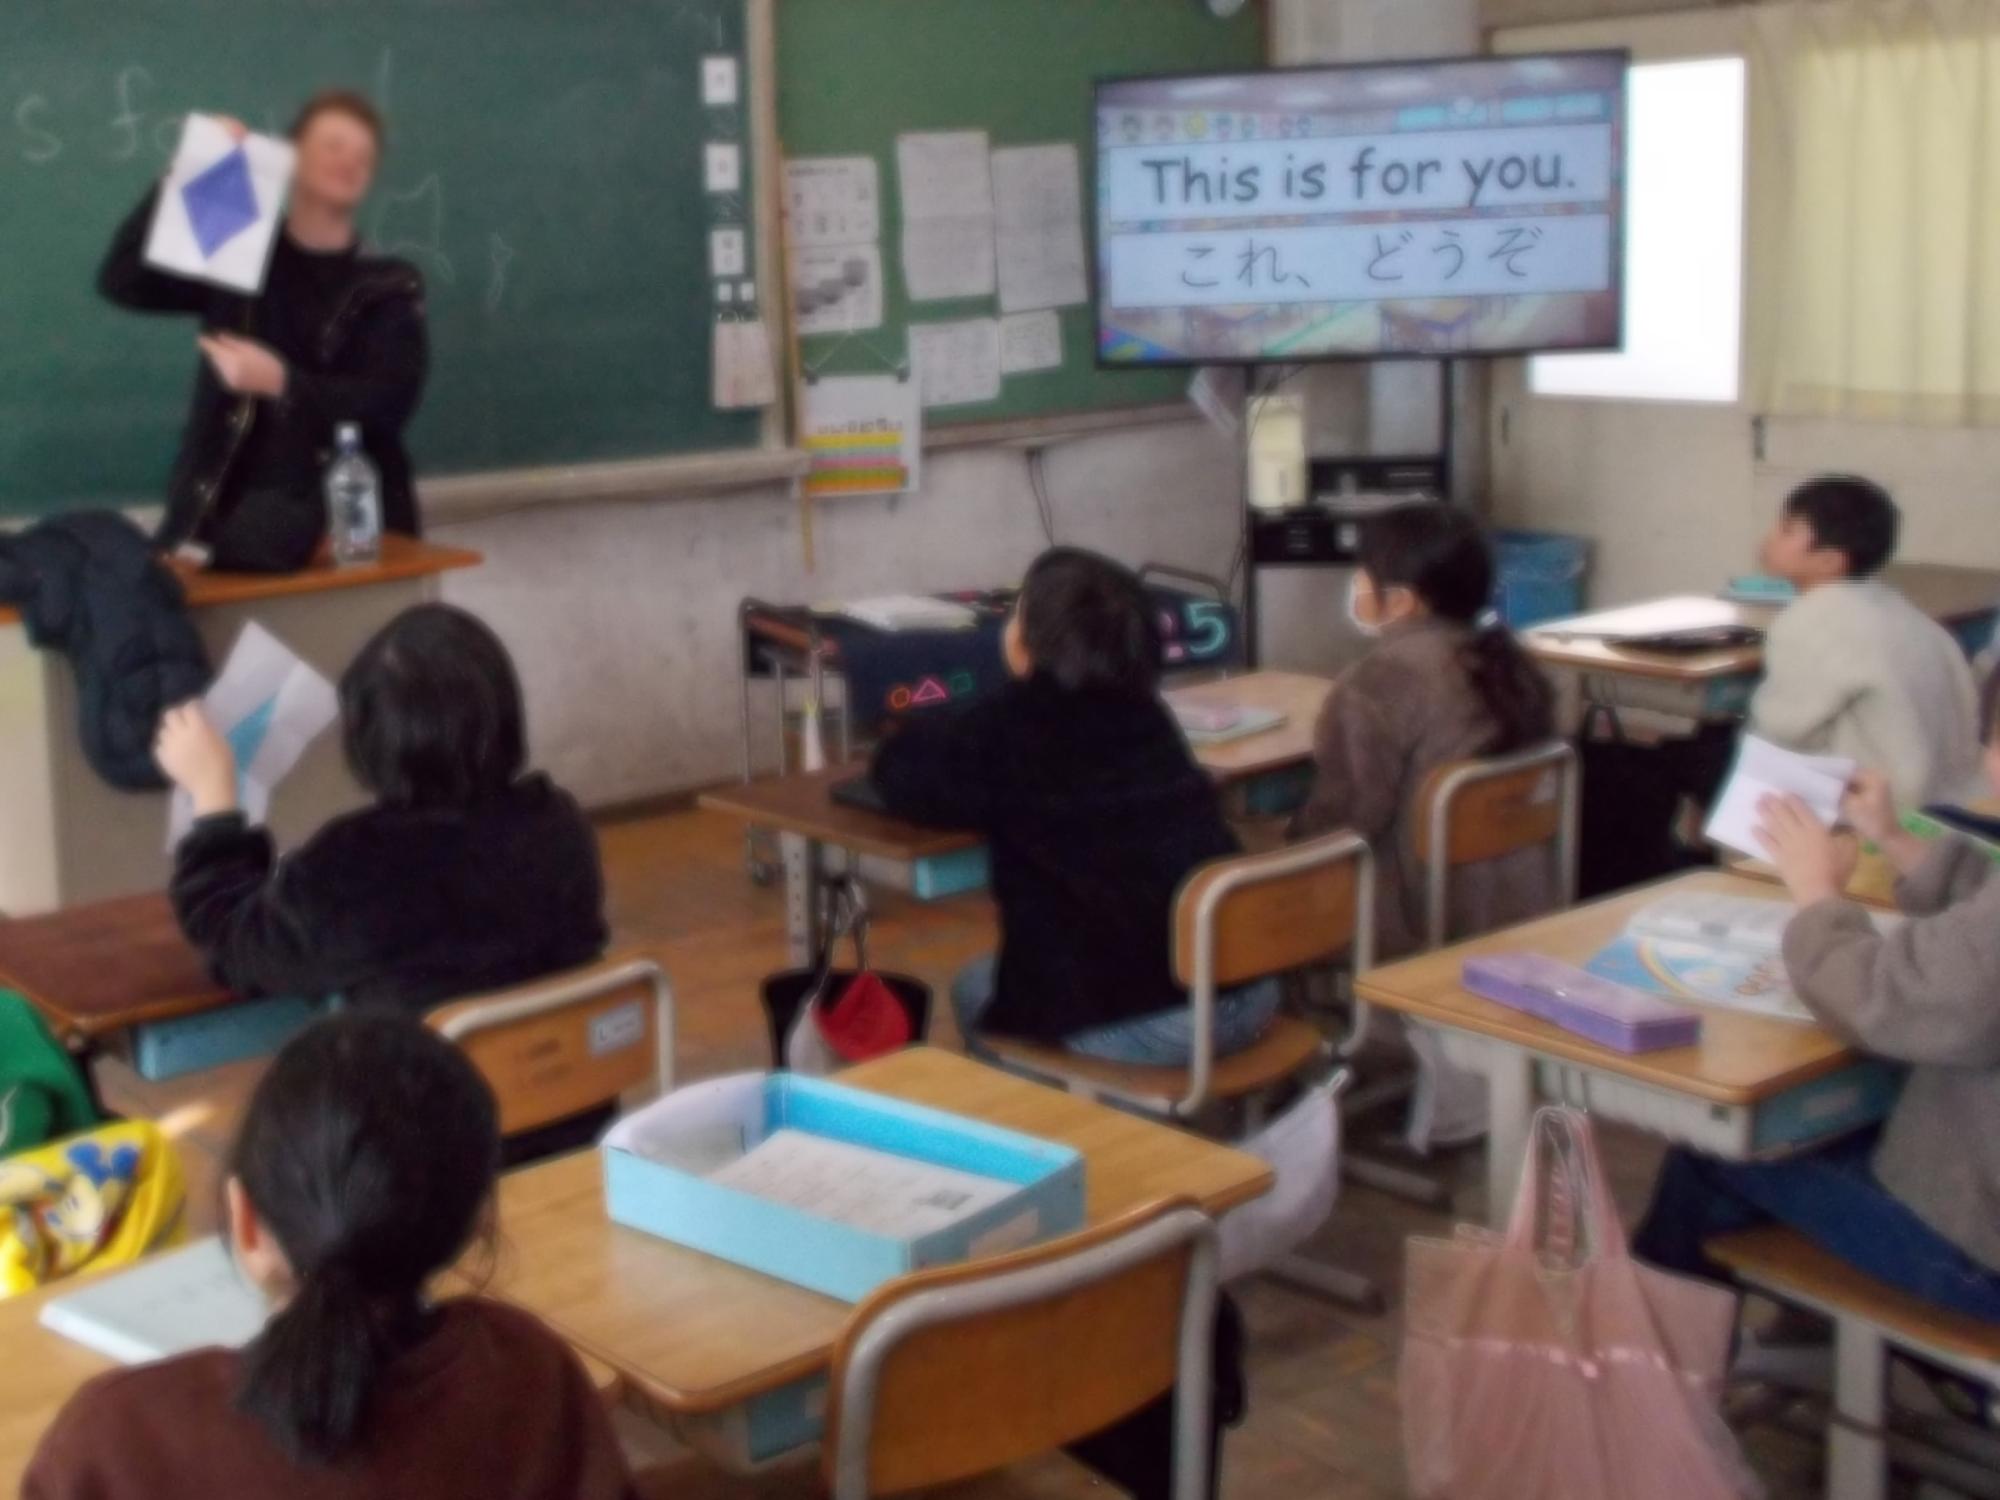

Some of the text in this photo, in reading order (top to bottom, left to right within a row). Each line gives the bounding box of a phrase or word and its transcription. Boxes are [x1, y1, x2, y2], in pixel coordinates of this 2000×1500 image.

[1142, 146, 1577, 208] This is for you.
[1180, 226, 1544, 289] これ、 どうぞ
